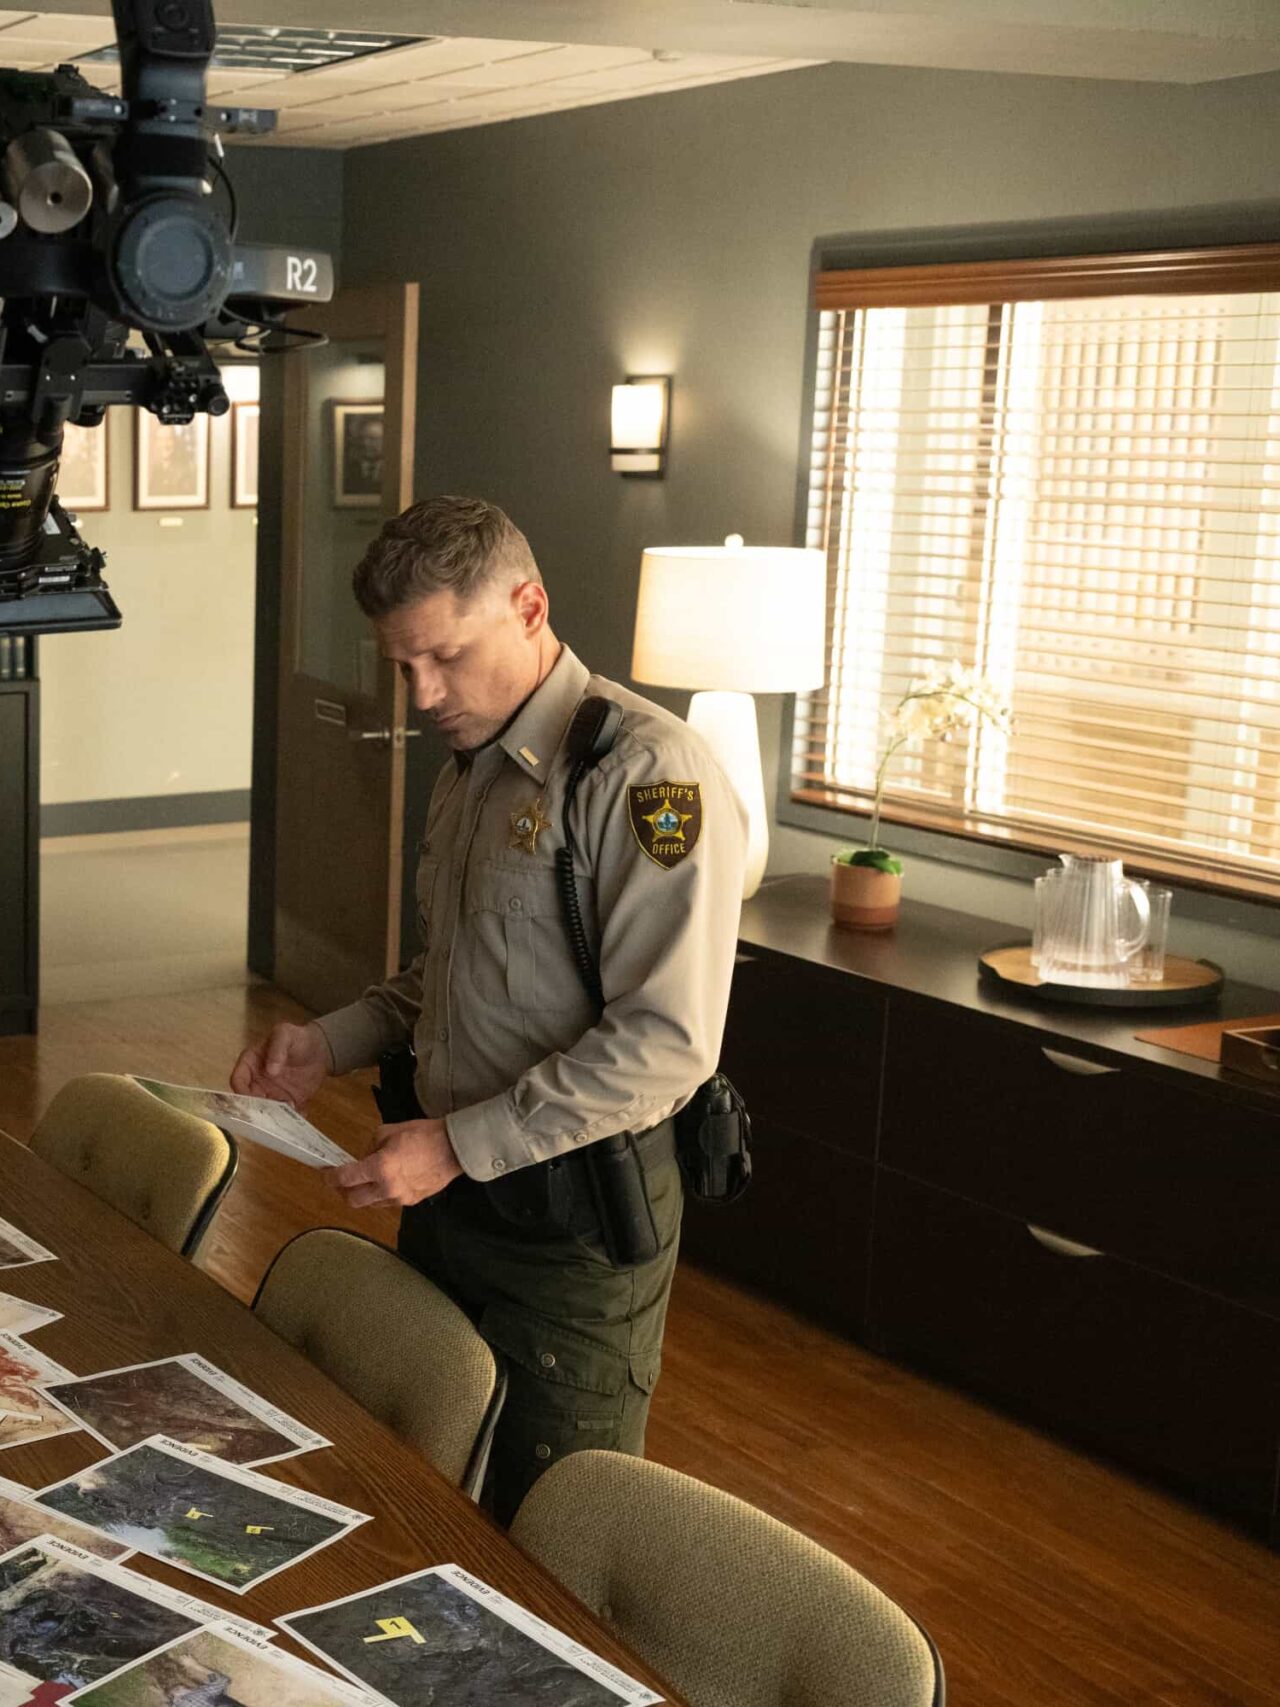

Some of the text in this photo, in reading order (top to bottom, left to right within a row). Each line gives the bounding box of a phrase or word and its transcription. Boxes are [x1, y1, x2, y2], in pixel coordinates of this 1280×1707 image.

[286, 256, 317, 292] R2
[636, 786, 694, 804] SHERIFF'S
[651, 843, 687, 855] OFFICE
[0, 1332, 27, 1350] EVIDENCE
[190, 1358, 217, 1376] EVIDENCE
[159, 1439, 199, 1457] EVIDENCE
[47, 1540, 90, 1560] EVIDENCE
[451, 1570, 491, 1596] EVIDENCE
[224, 1626, 269, 1650] EVIDENCE
